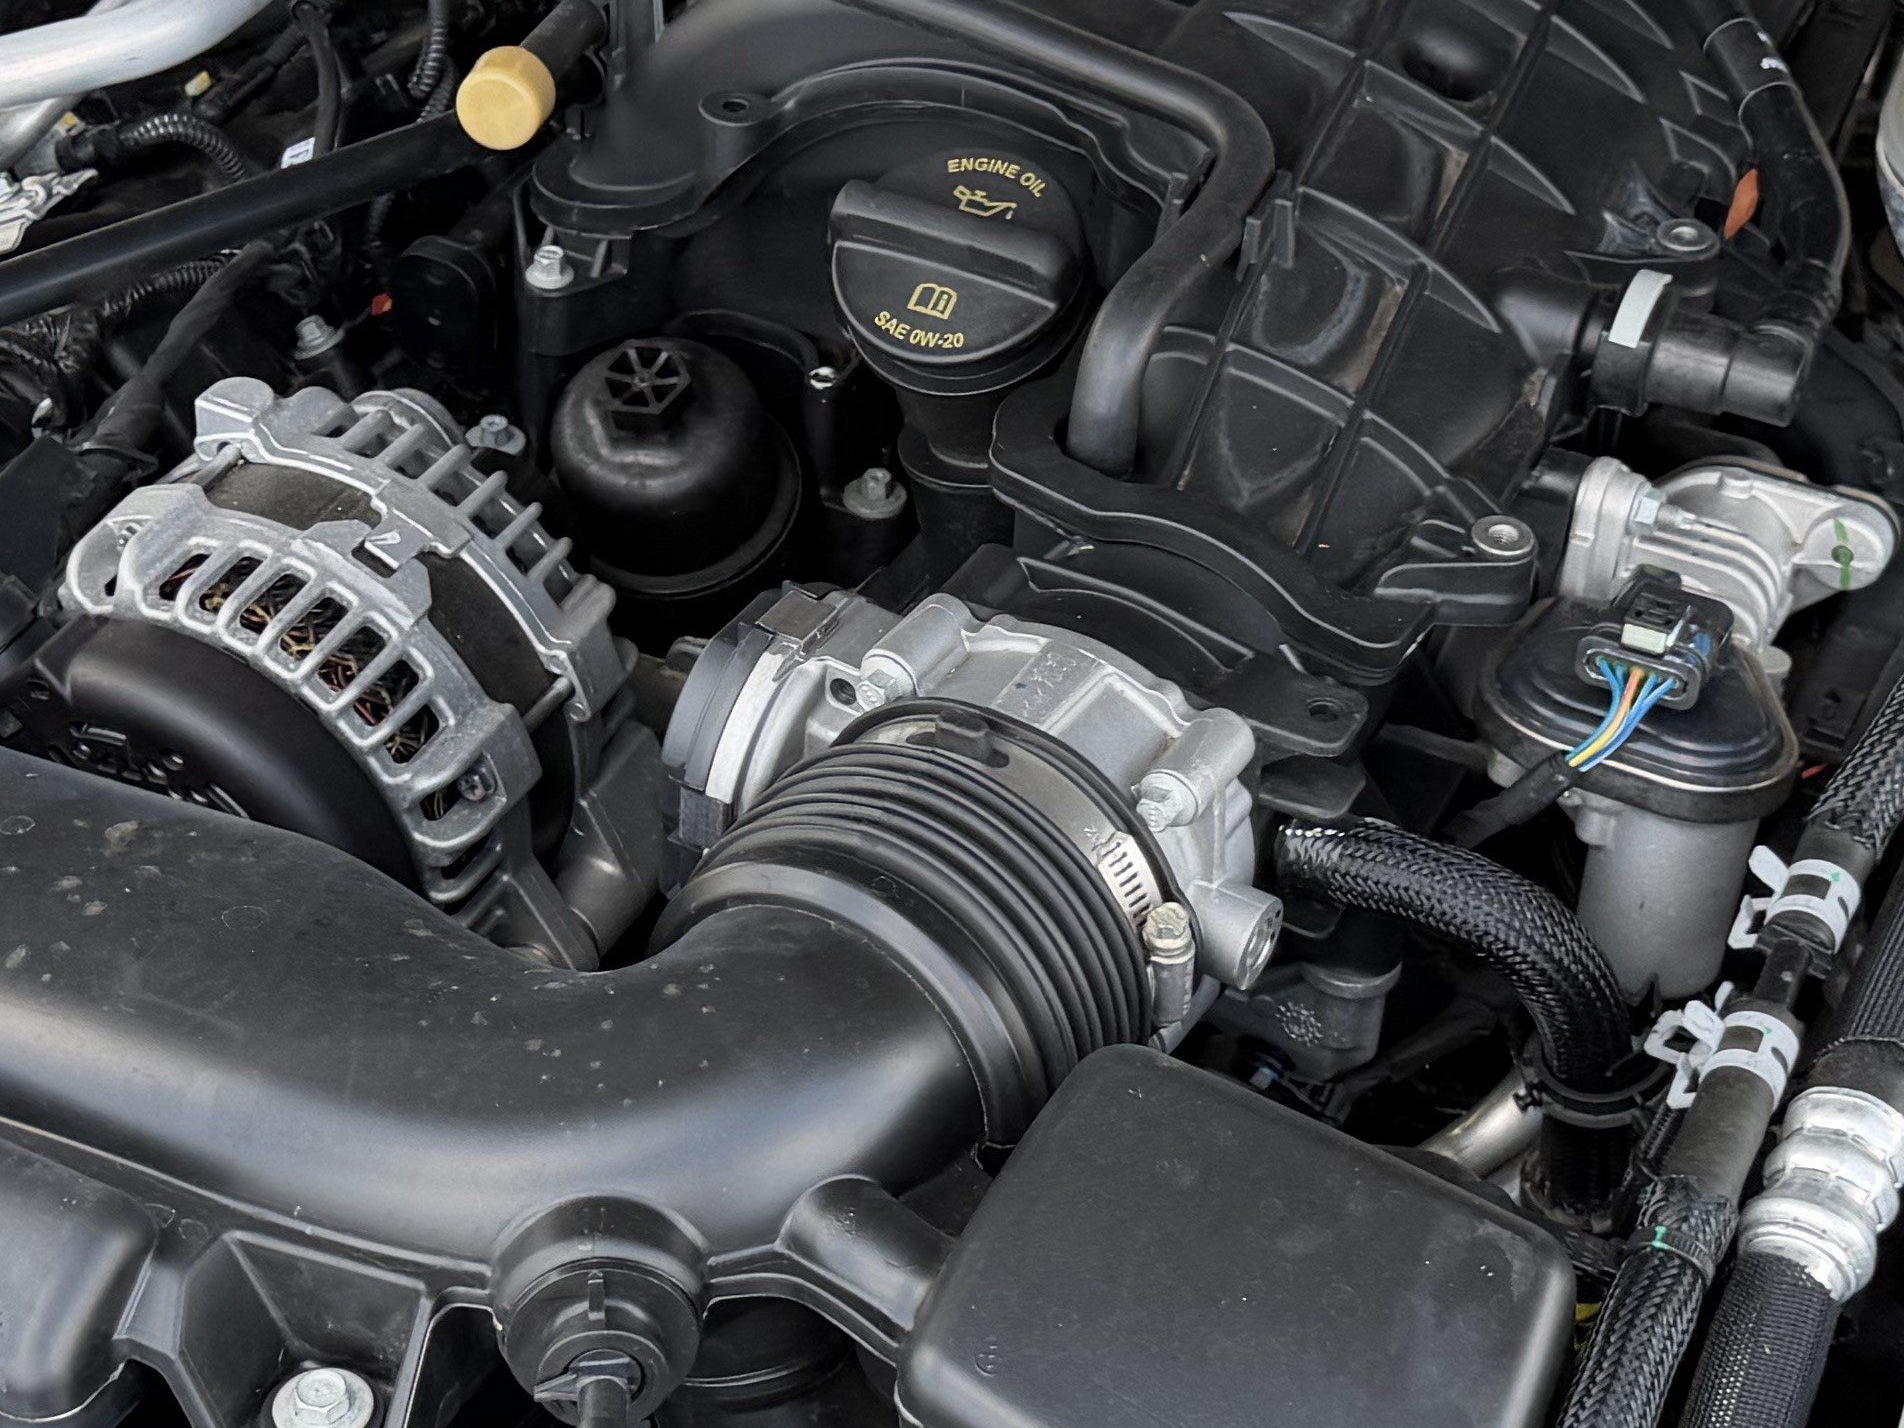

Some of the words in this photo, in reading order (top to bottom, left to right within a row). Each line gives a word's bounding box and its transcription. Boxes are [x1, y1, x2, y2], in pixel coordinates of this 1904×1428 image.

[947, 157, 1020, 180] ENGINE
[1020, 172, 1047, 198] OIL
[874, 311, 904, 340] SAE
[909, 328, 964, 349] 0W-20
